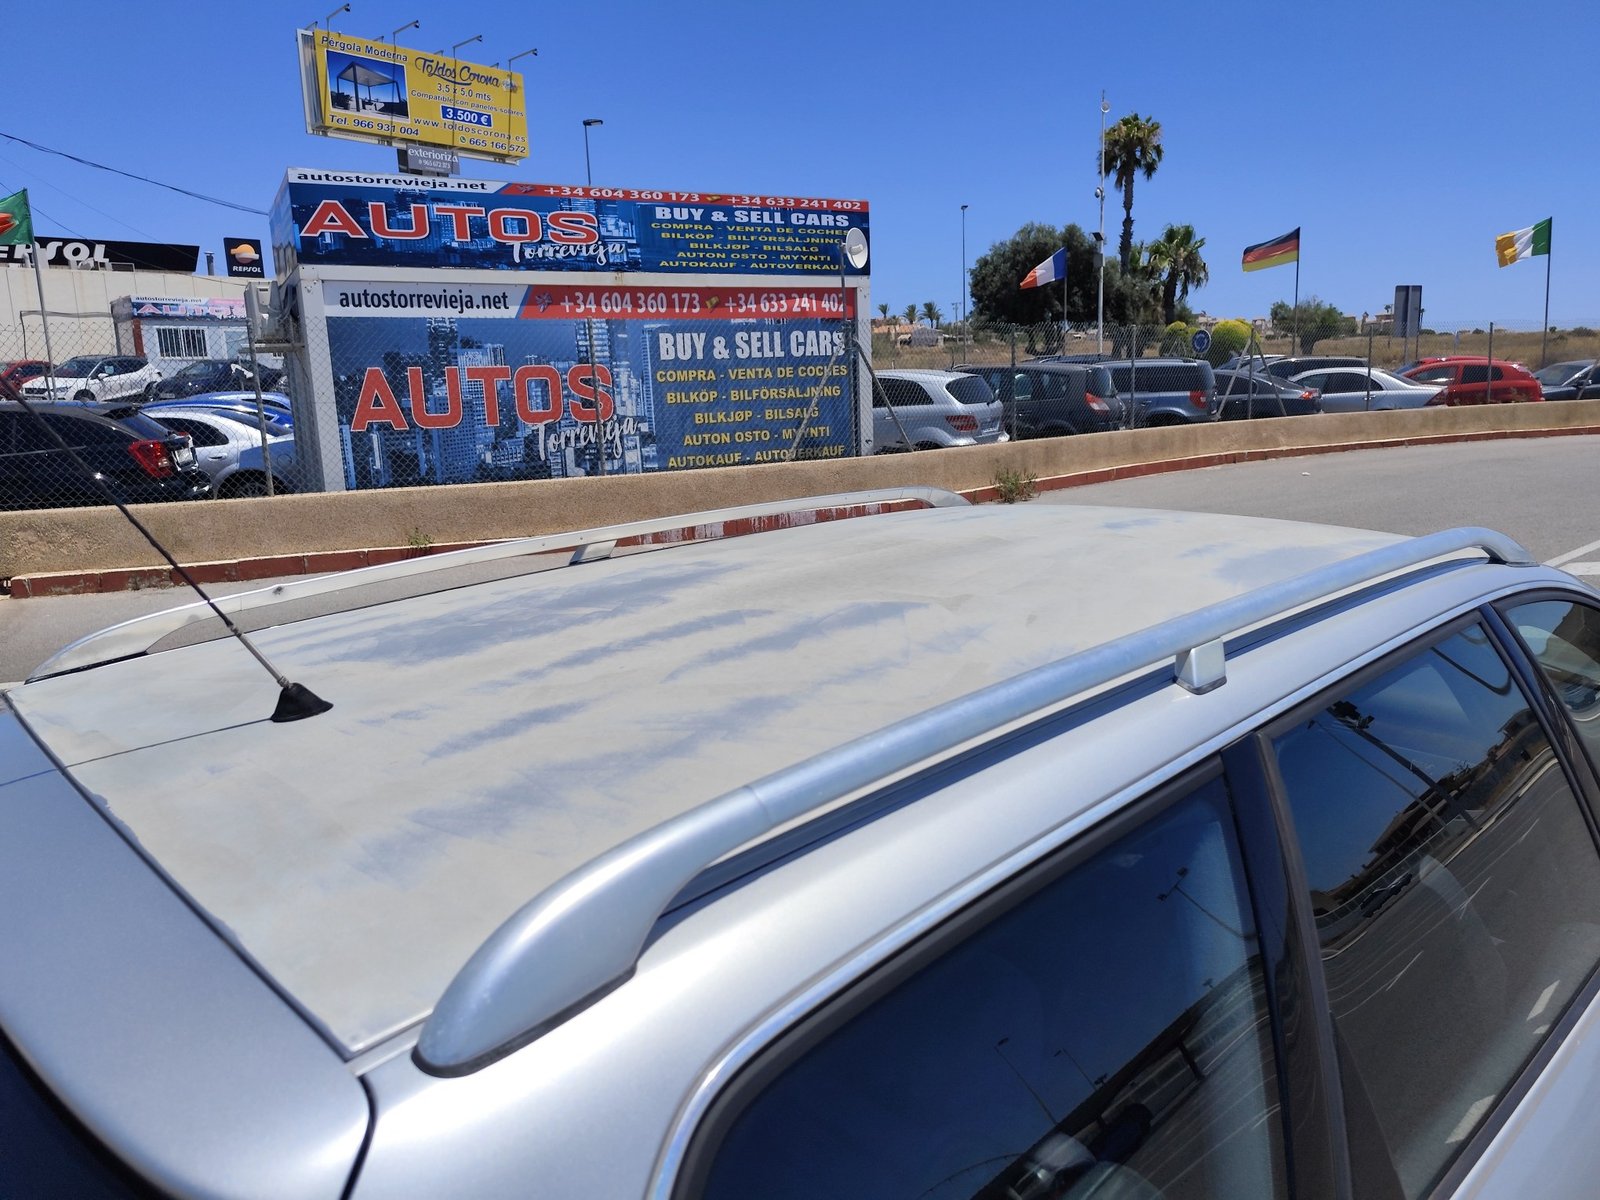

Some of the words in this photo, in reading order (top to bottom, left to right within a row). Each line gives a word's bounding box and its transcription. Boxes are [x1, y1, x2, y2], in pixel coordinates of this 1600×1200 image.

[365, 45, 408, 62] Moderna
[415, 57, 457, 80] Toldos
[460, 66, 501, 87] Corona
[411, 90, 454, 103] Compatible
[471, 101, 497, 112] paneles
[500, 107, 524, 116] solares
[329, 114, 349, 125] Tel.
[353, 118, 374, 129] 966
[377, 122, 396, 132] 931
[400, 126, 419, 136] 004
[446, 108, 478, 123] 3.500
[481, 115, 489, 126] €
[469, 138, 487, 147] 665
[491, 140, 507, 150] 166
[509, 144, 526, 153] 572
[408, 148, 459, 163] exterioriza
[297, 172, 488, 191] autostorrevieja.net
[544, 187, 585, 196] +34
[589, 188, 625, 198] 604
[630, 191, 663, 200] 360
[669, 192, 700, 202] 173
[727, 196, 761, 205] +34
[766, 197, 795, 207] 633
[800, 199, 828, 209] 241
[833, 201, 861, 210] 402
[300, 199, 599, 245] AUTOS
[655, 206, 704, 221] BUY
[711, 210, 728, 222] &
[735, 209, 785, 225] SELL
[791, 212, 850, 227] CARS
[651, 222, 713, 231] COMPRA
[726, 225, 772, 233] VENTA
[798, 228, 848, 236] COCHES
[660, 231, 715, 240] BILKÖP
[506, 241, 626, 266] Torrevieja
[689, 242, 751, 250] BILKJØP
[763, 244, 819, 253] BILSALG
[659, 260, 737, 268] AUTOKAUF
[676, 251, 727, 259] AUTON
[731, 252, 768, 260] OSTO
[780, 254, 831, 262] MYYNTI
[232, 265, 262, 273] REPSOL
[339, 289, 510, 314] autostorrevieja.net
[560, 292, 597, 314] +34
[601, 292, 631, 314] 604
[637, 292, 668, 314] 360
[671, 293, 701, 314] 173
[725, 293, 757, 313] +34
[760, 293, 788, 313] 633
[791, 293, 818, 312] 241
[658, 331, 706, 361] BUY
[712, 336, 730, 360] &
[735, 331, 785, 359] SELL
[790, 330, 845, 358] CARS
[656, 369, 717, 382] COMPRA
[728, 367, 773, 380] VENTA
[777, 366, 795, 378] DE
[351, 364, 615, 432] AUTOS
[666, 389, 718, 404] BILKÖP
[694, 410, 753, 424] BILKJØP
[532, 414, 639, 461] Torrevieja
[683, 432, 731, 446] AUTON
[735, 430, 771, 442] OSTO
[668, 452, 742, 468] AUTOKAUF
